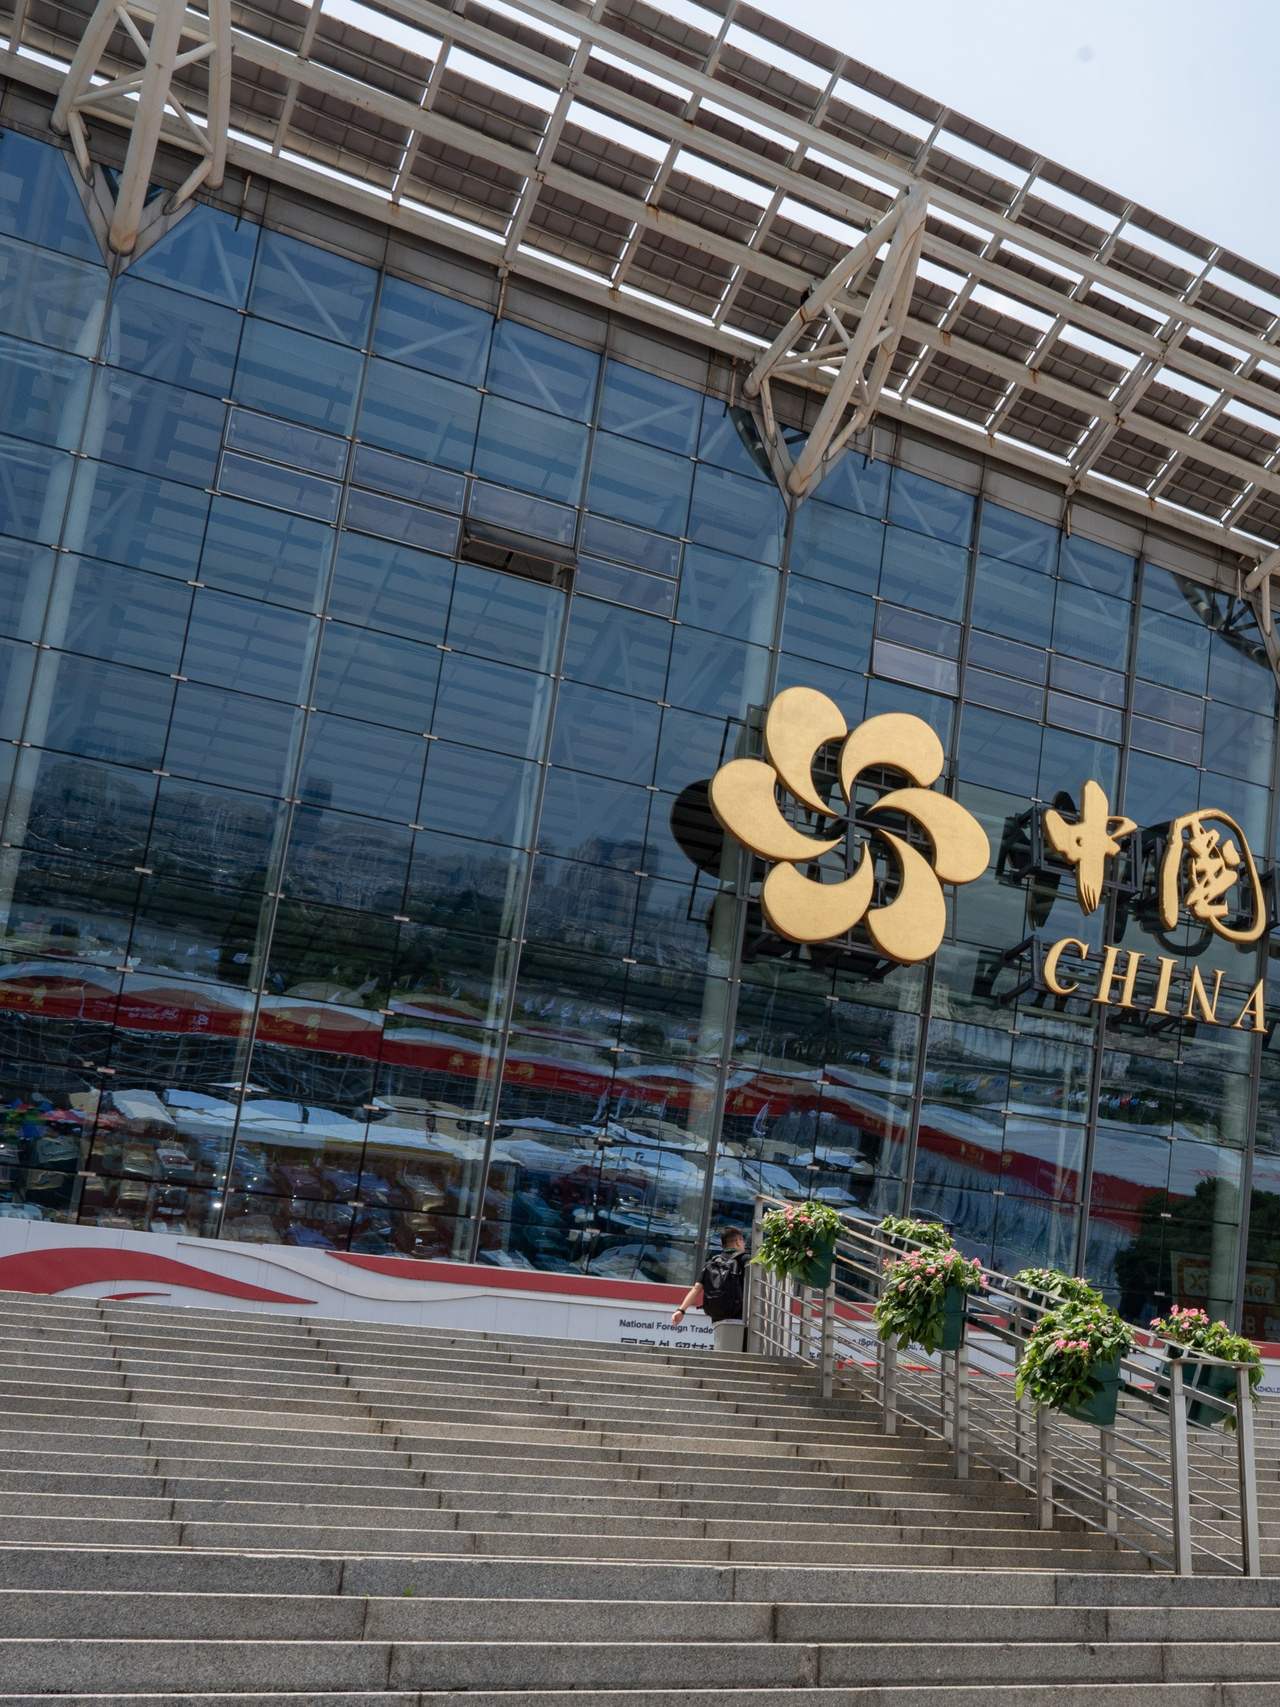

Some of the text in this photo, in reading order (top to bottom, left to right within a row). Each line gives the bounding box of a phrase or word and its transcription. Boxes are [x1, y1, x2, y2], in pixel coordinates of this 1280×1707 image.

[1042, 937, 1269, 1034] CHINA
[619, 1319, 714, 1334] National Foreign Trade
